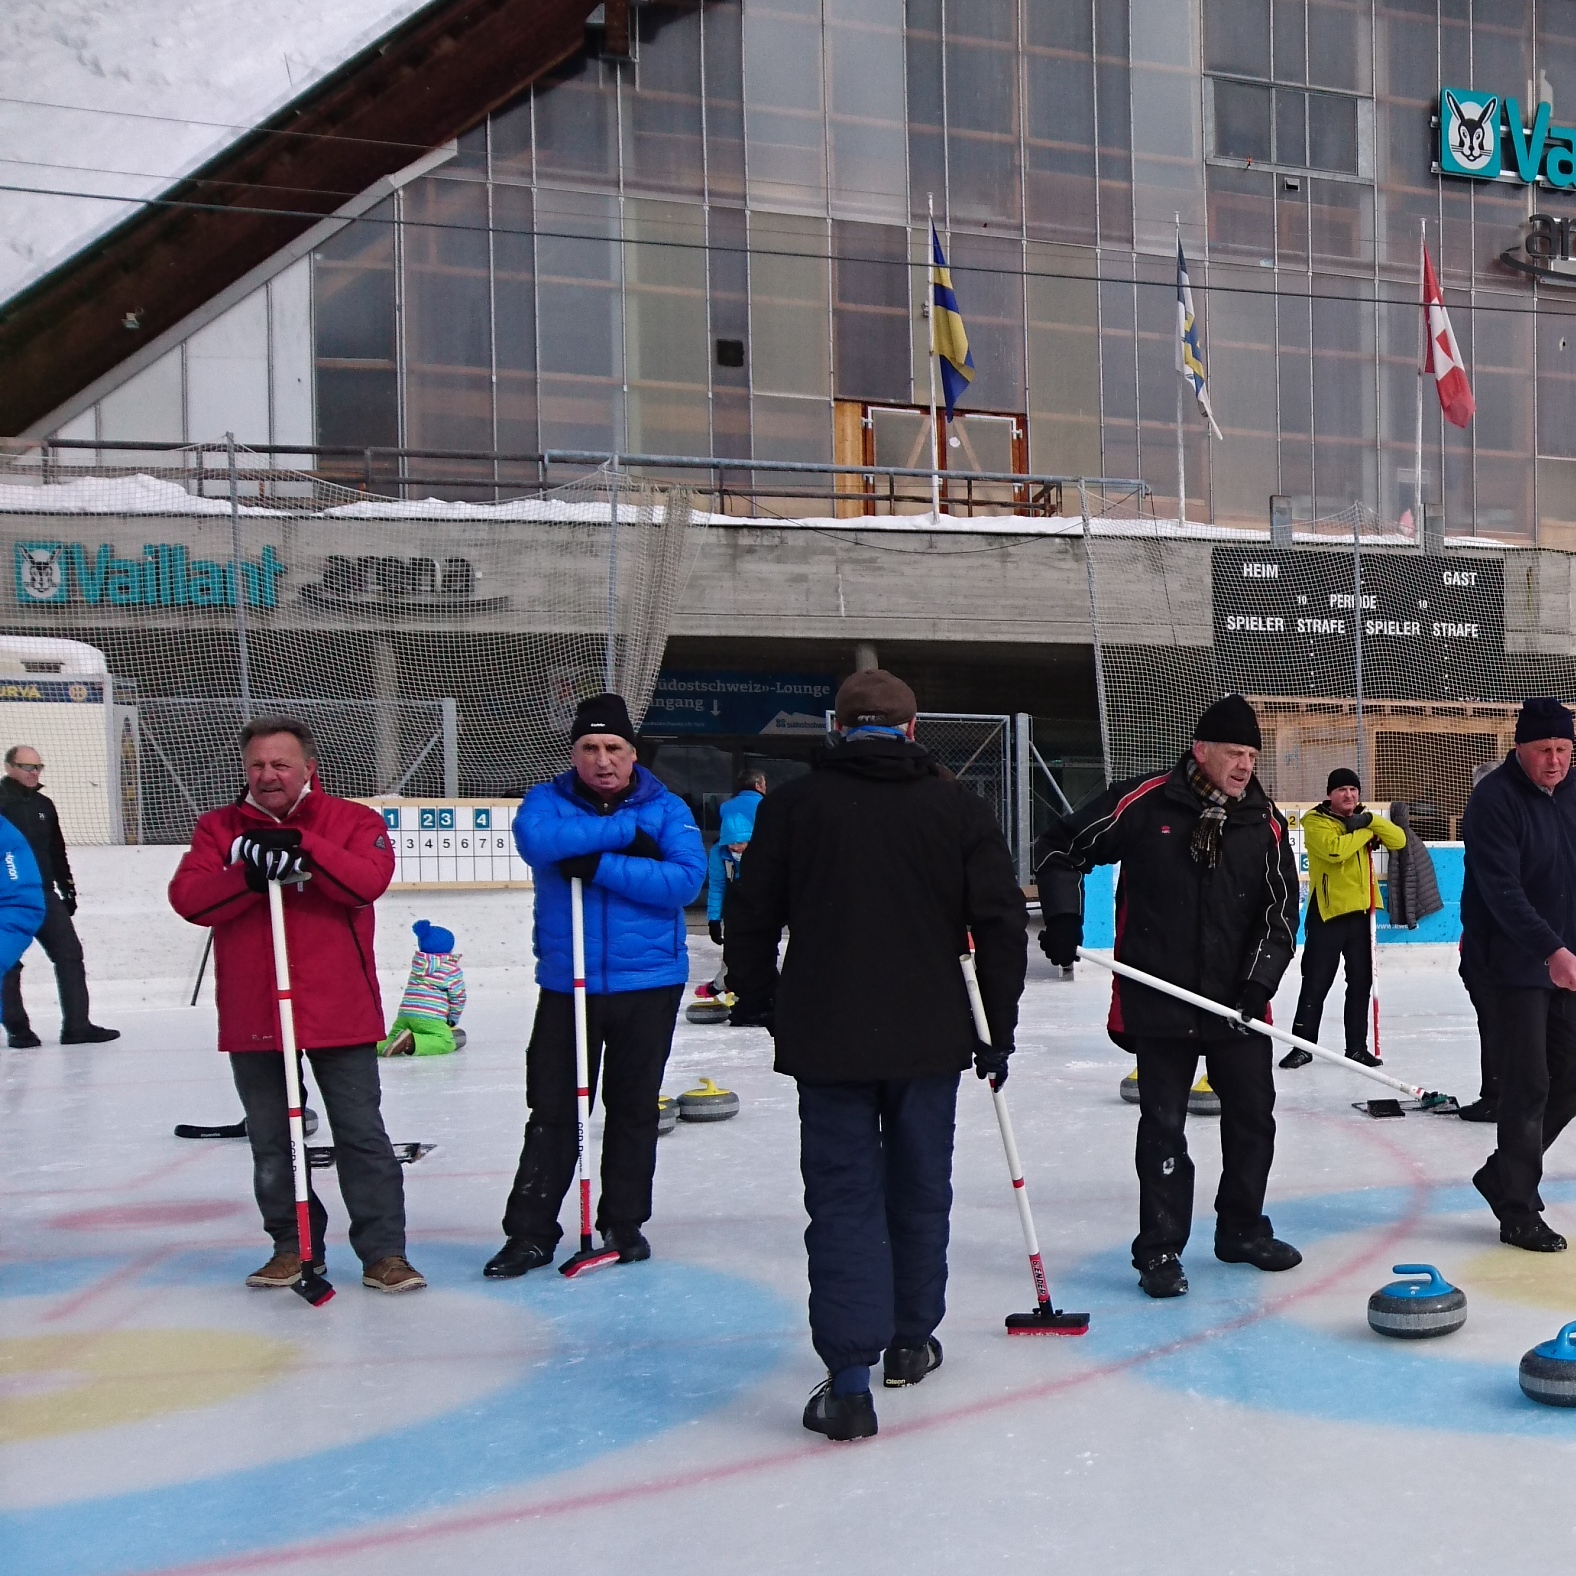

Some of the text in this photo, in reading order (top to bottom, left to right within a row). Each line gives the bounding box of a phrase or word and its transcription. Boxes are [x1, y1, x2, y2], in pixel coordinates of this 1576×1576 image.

[66, 542, 288, 608] Vaillant
[1243, 563, 1279, 579] HEIM
[1443, 571, 1478, 586] GAST
[1330, 594, 1377, 609] PERIDE
[1227, 616, 1345, 634] SPIELER STRAFE
[1366, 621, 1479, 638] SPIELER STRAFE
[387, 813, 487, 826] 1 2 3 4
[1289, 816, 1296, 826] 2
[406, 839, 414, 849] 3
[425, 839, 433, 849] 4
[443, 839, 451, 849] 5
[461, 839, 469, 849] 6
[479, 839, 487, 849] 7
[497, 839, 504, 849] 8
